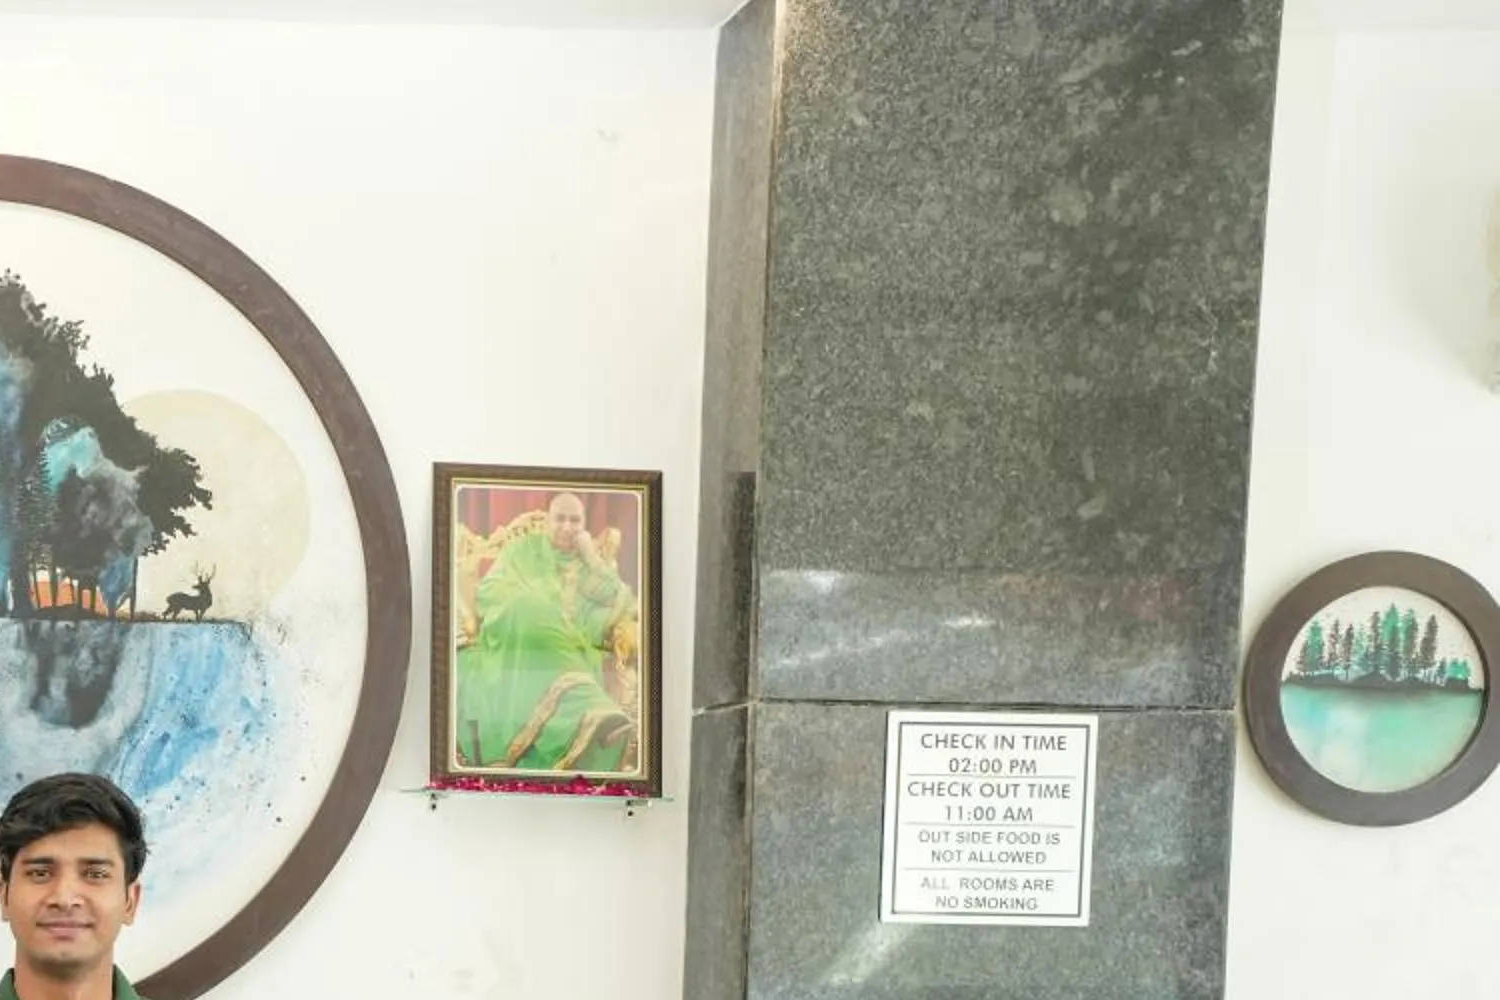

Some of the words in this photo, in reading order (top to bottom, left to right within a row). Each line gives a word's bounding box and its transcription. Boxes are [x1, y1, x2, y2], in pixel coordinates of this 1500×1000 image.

[920, 732, 987, 750] CHECK
[994, 734, 1016, 751] IN
[1022, 735, 1067, 751] TIME
[949, 757, 1002, 774] 02:00
[1008, 758, 1037, 774] PM
[907, 780, 972, 797] CHECK
[979, 782, 1020, 799] OUT
[1027, 783, 1071, 800] TIME
[945, 805, 996, 821] 11:00
[1002, 806, 1033, 822] AM
[918, 829, 950, 843] OUT
[955, 831, 992, 845] SIDE
[996, 831, 1041, 845] FOOD
[1046, 832, 1061, 845] IS
[931, 849, 963, 864] NOT
[967, 850, 1047, 865] ALLOWED
[920, 876, 950, 890] ALL
[959, 877, 1019, 892] ROOMS
[1022, 878, 1055, 892] ARE
[935, 896, 959, 910] NO
[963, 896, 1039, 911] SMOKING
